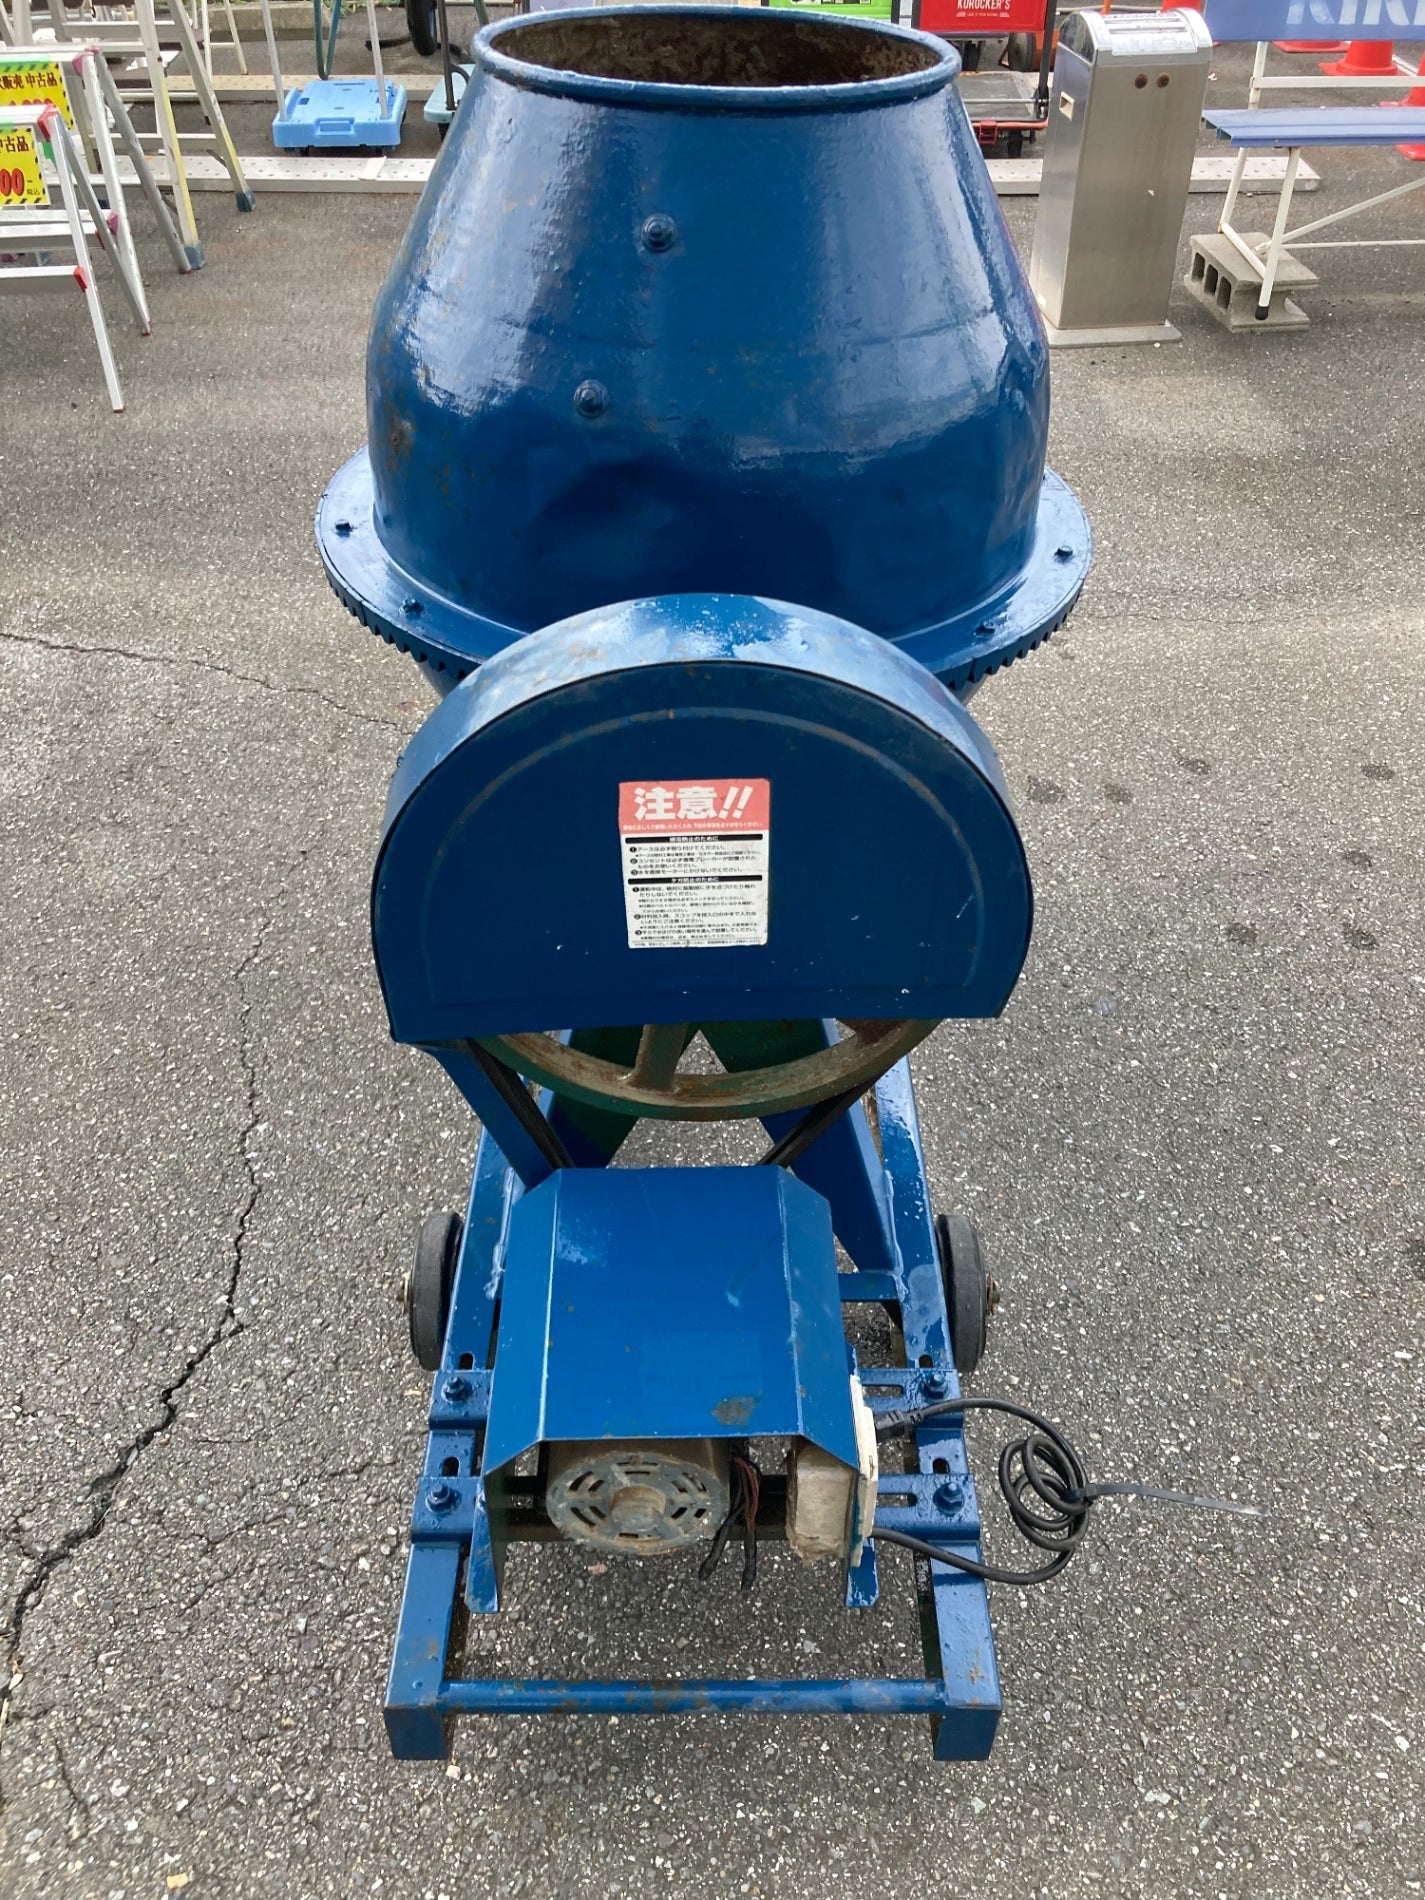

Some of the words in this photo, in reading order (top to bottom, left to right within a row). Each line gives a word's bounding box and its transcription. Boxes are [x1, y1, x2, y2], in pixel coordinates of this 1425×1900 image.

[26, 72, 58, 89] 中古品
[0, 135, 29, 153] 古品
[634, 785, 753, 820] 注意!!
